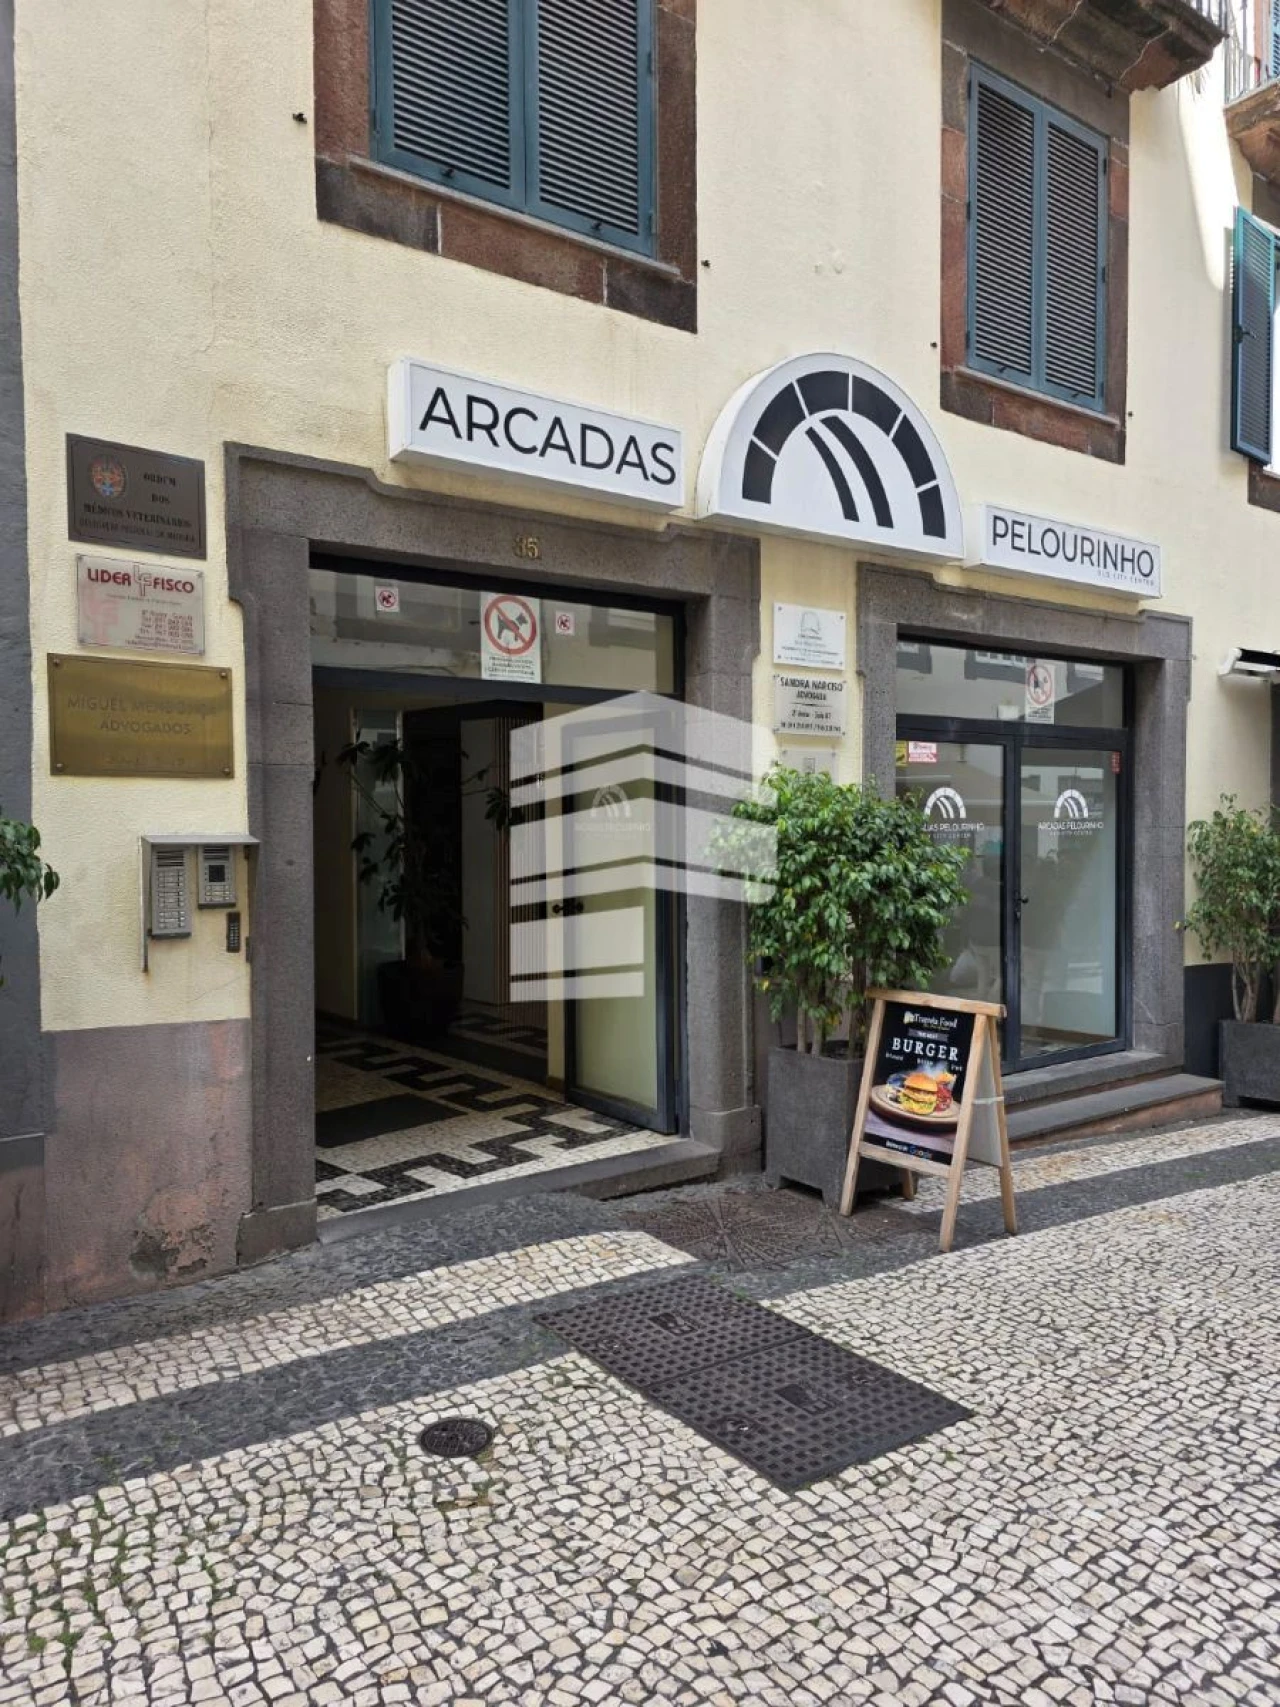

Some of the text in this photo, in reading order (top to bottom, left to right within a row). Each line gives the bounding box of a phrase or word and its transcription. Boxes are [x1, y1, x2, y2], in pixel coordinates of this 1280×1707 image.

[419, 387, 676, 485] ARCADAS
[151, 493, 171, 504] DOS
[992, 515, 1154, 578] PELOURINHO
[87, 568, 132, 587] LIDER
[153, 577, 195, 594] FISCO
[780, 677, 843, 692] SANDRA NARCISO
[67, 695, 127, 713] MIGUEL
[100, 720, 193, 735] ADVOGADOS
[940, 822, 985, 832] PELOURINHO
[1037, 821, 1104, 831] ARCADAS PELOURINHO
[940, 1017, 958, 1028] Food
[892, 1037, 958, 1061] BURGER
